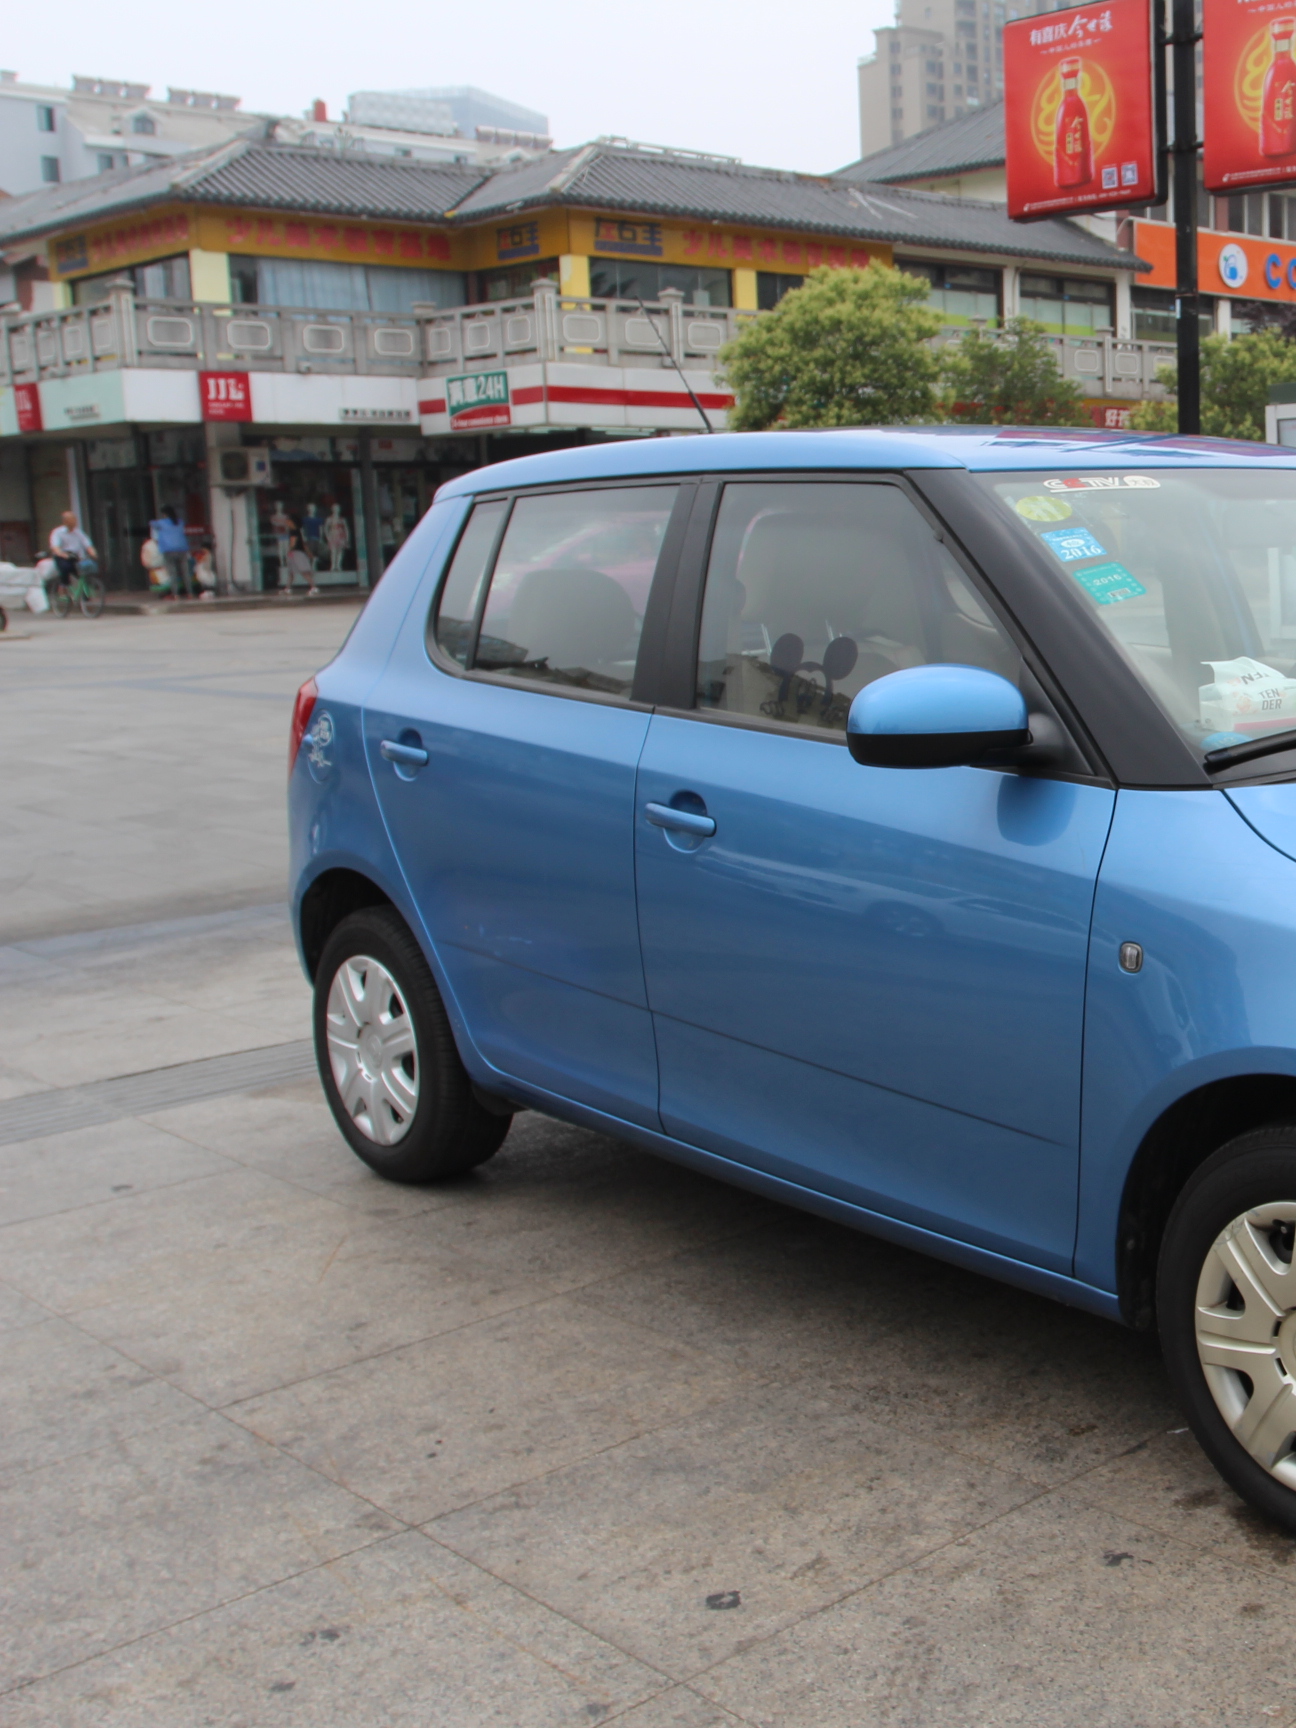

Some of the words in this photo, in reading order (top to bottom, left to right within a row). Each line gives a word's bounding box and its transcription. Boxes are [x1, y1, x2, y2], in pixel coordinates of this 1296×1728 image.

[1061, 544, 1102, 561] 2016
[1093, 573, 1123, 586] 2016
[1259, 688, 1281, 699] TEN
[1261, 699, 1283, 711] DER
